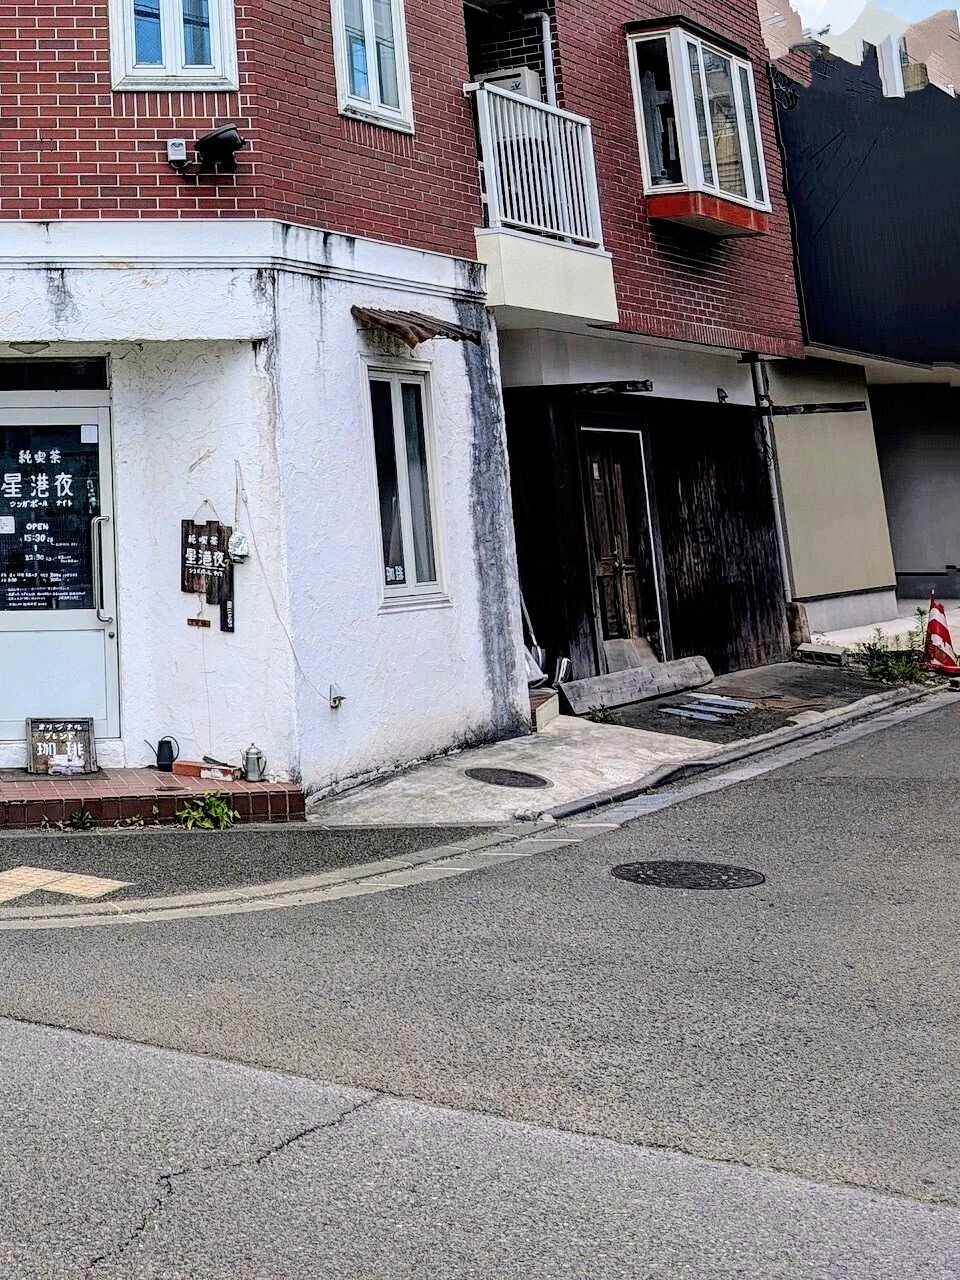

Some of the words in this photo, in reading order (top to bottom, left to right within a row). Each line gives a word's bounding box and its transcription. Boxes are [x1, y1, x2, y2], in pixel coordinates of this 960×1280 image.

[19, 449, 61, 464] 純喫茶
[0, 472, 74, 498] 星港夜
[24, 534, 46, 542] 15:30
[185, 548, 226, 567] 星港夜
[38, 723, 82, 731] オリジナル
[44, 732, 76, 740] ブレンド
[36, 741, 85, 756] 珈琲
